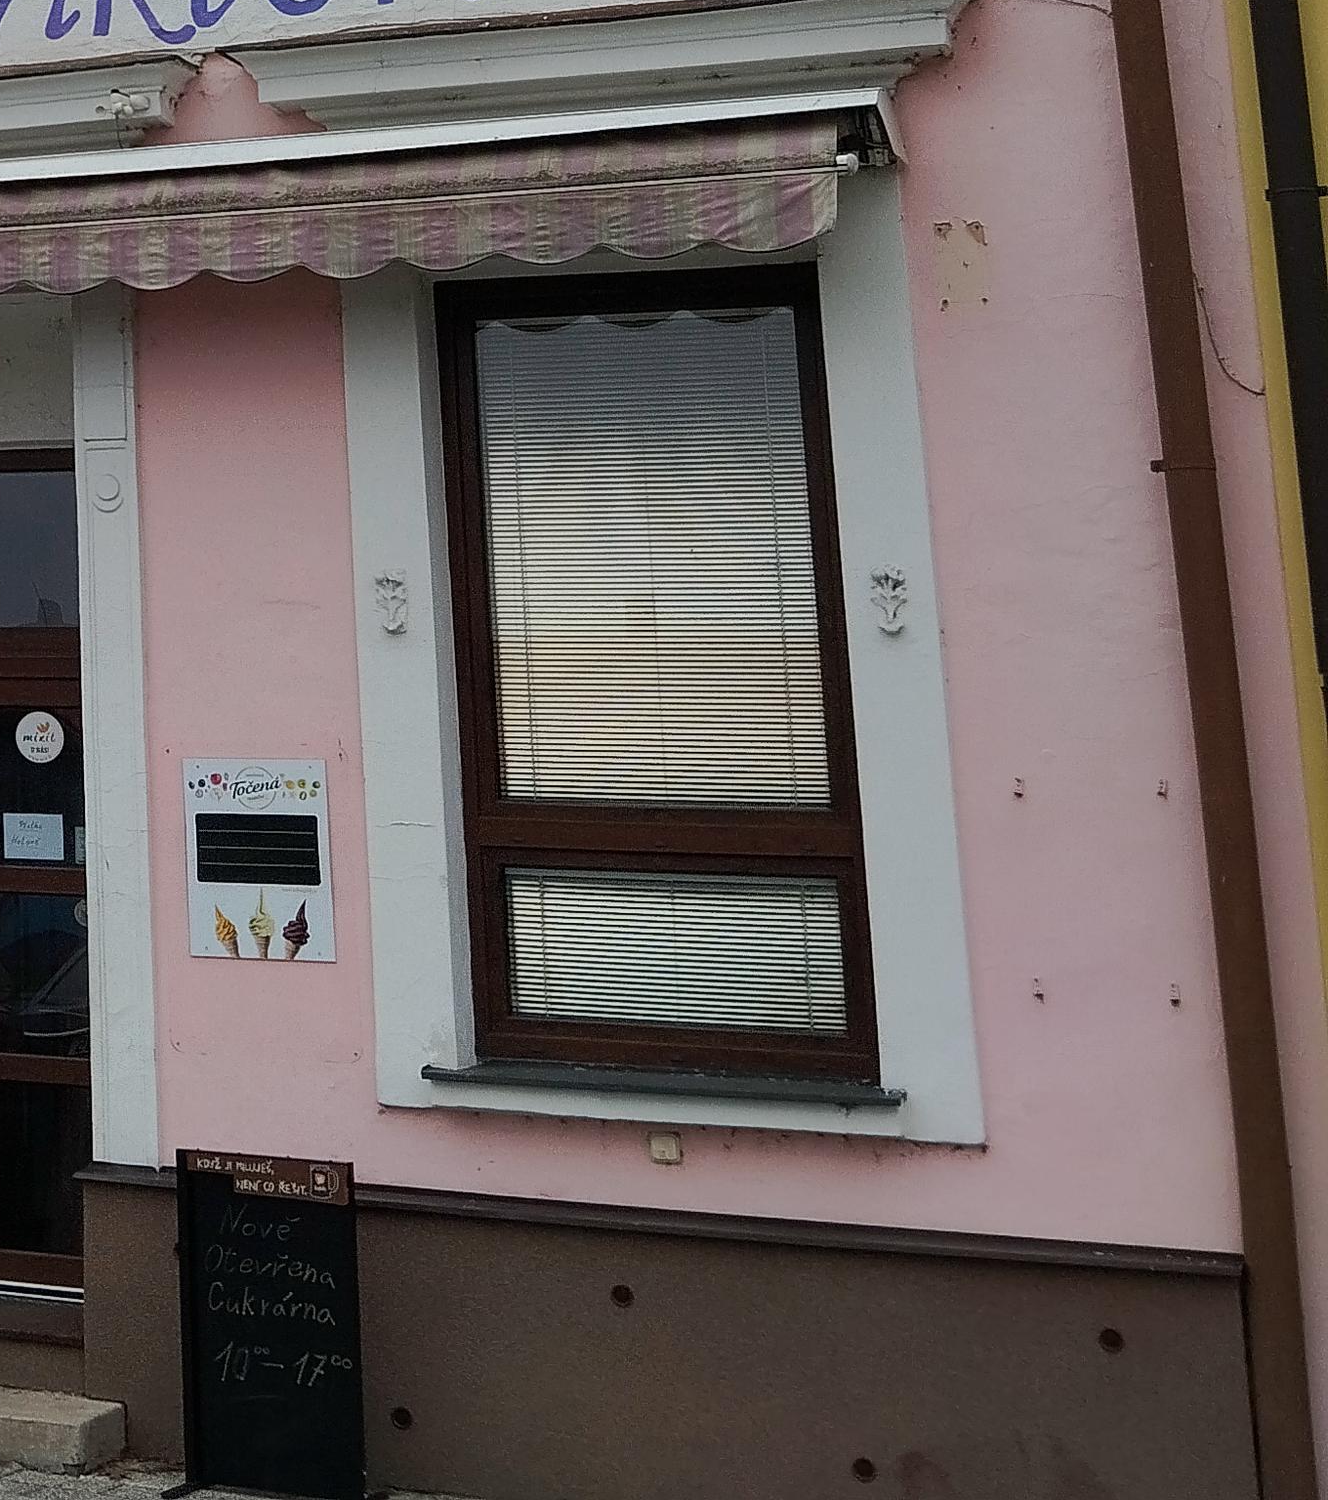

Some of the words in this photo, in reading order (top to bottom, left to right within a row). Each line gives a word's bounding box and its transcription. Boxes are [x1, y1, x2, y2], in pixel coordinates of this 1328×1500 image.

[229, 777, 282, 800] Točená
[204, 1243, 337, 1291] Otevřena
[207, 1280, 337, 1327] Cukrárna
